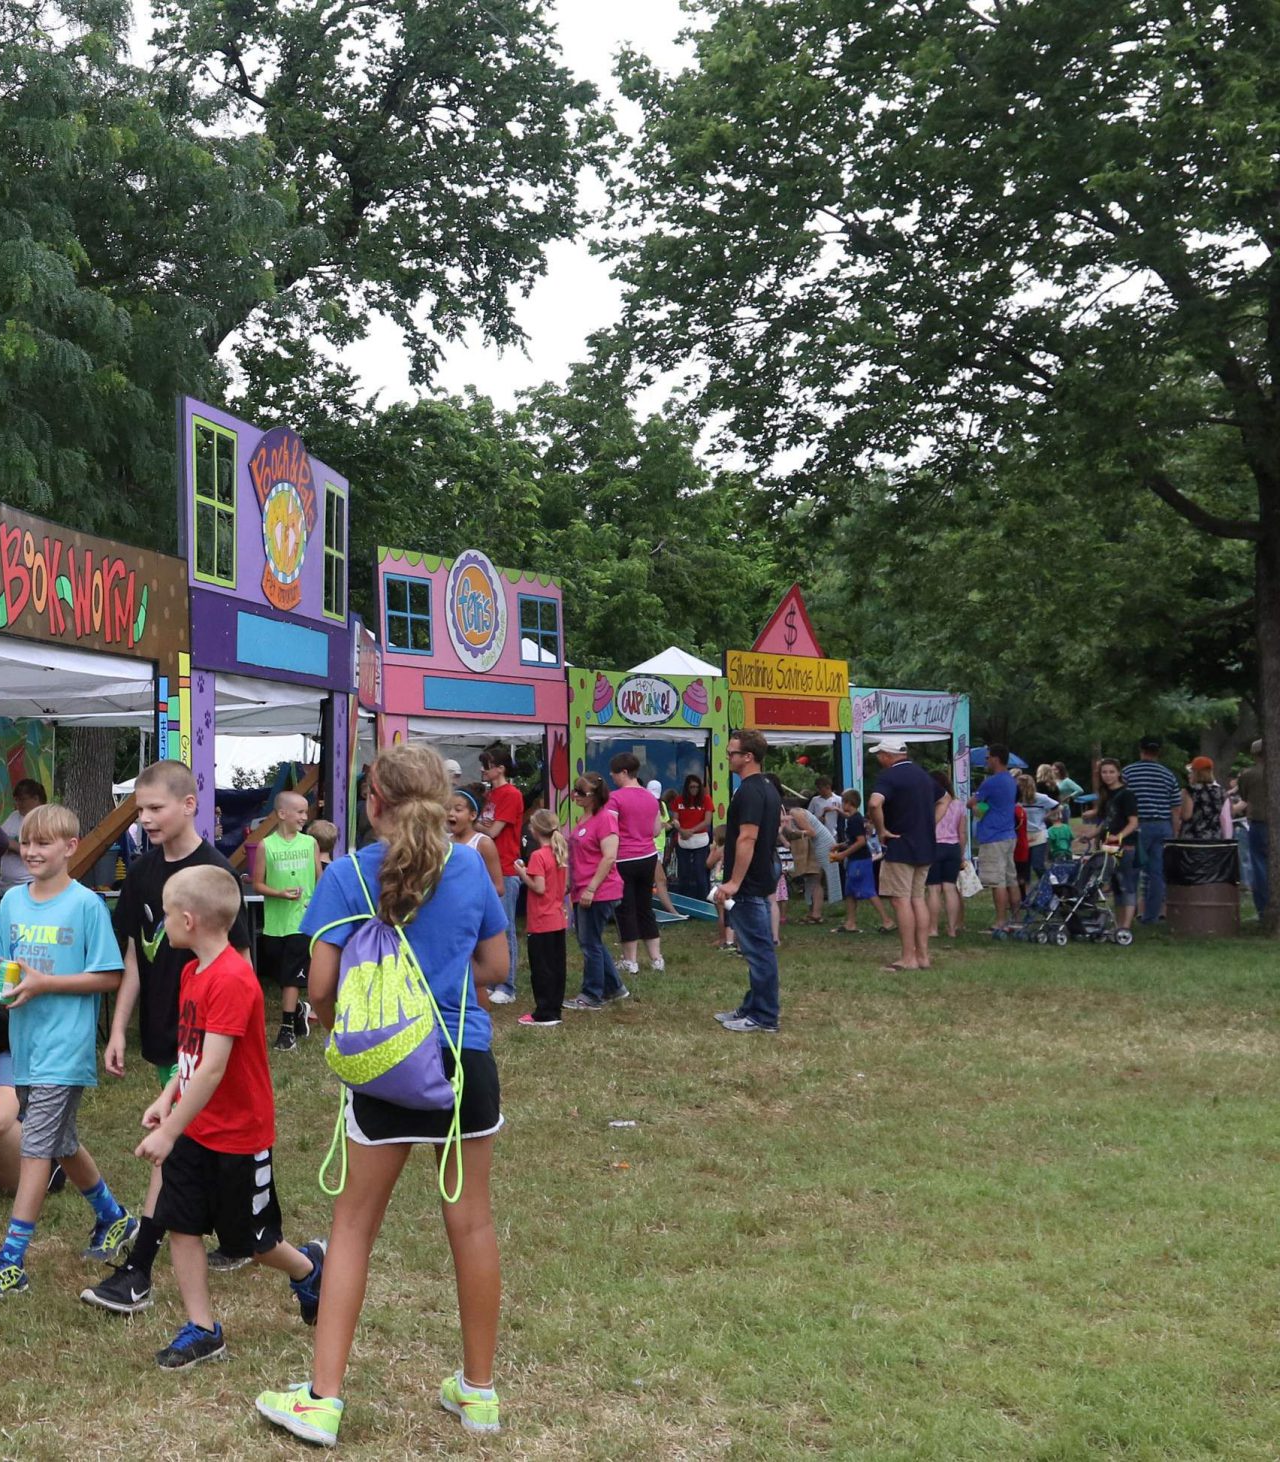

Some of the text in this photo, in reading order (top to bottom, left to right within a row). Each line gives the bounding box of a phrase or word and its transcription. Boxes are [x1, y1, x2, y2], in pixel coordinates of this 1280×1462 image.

[775, 658, 813, 692] Savings
[10, 923, 75, 946] SWING
[19, 944, 51, 958] FAST.
